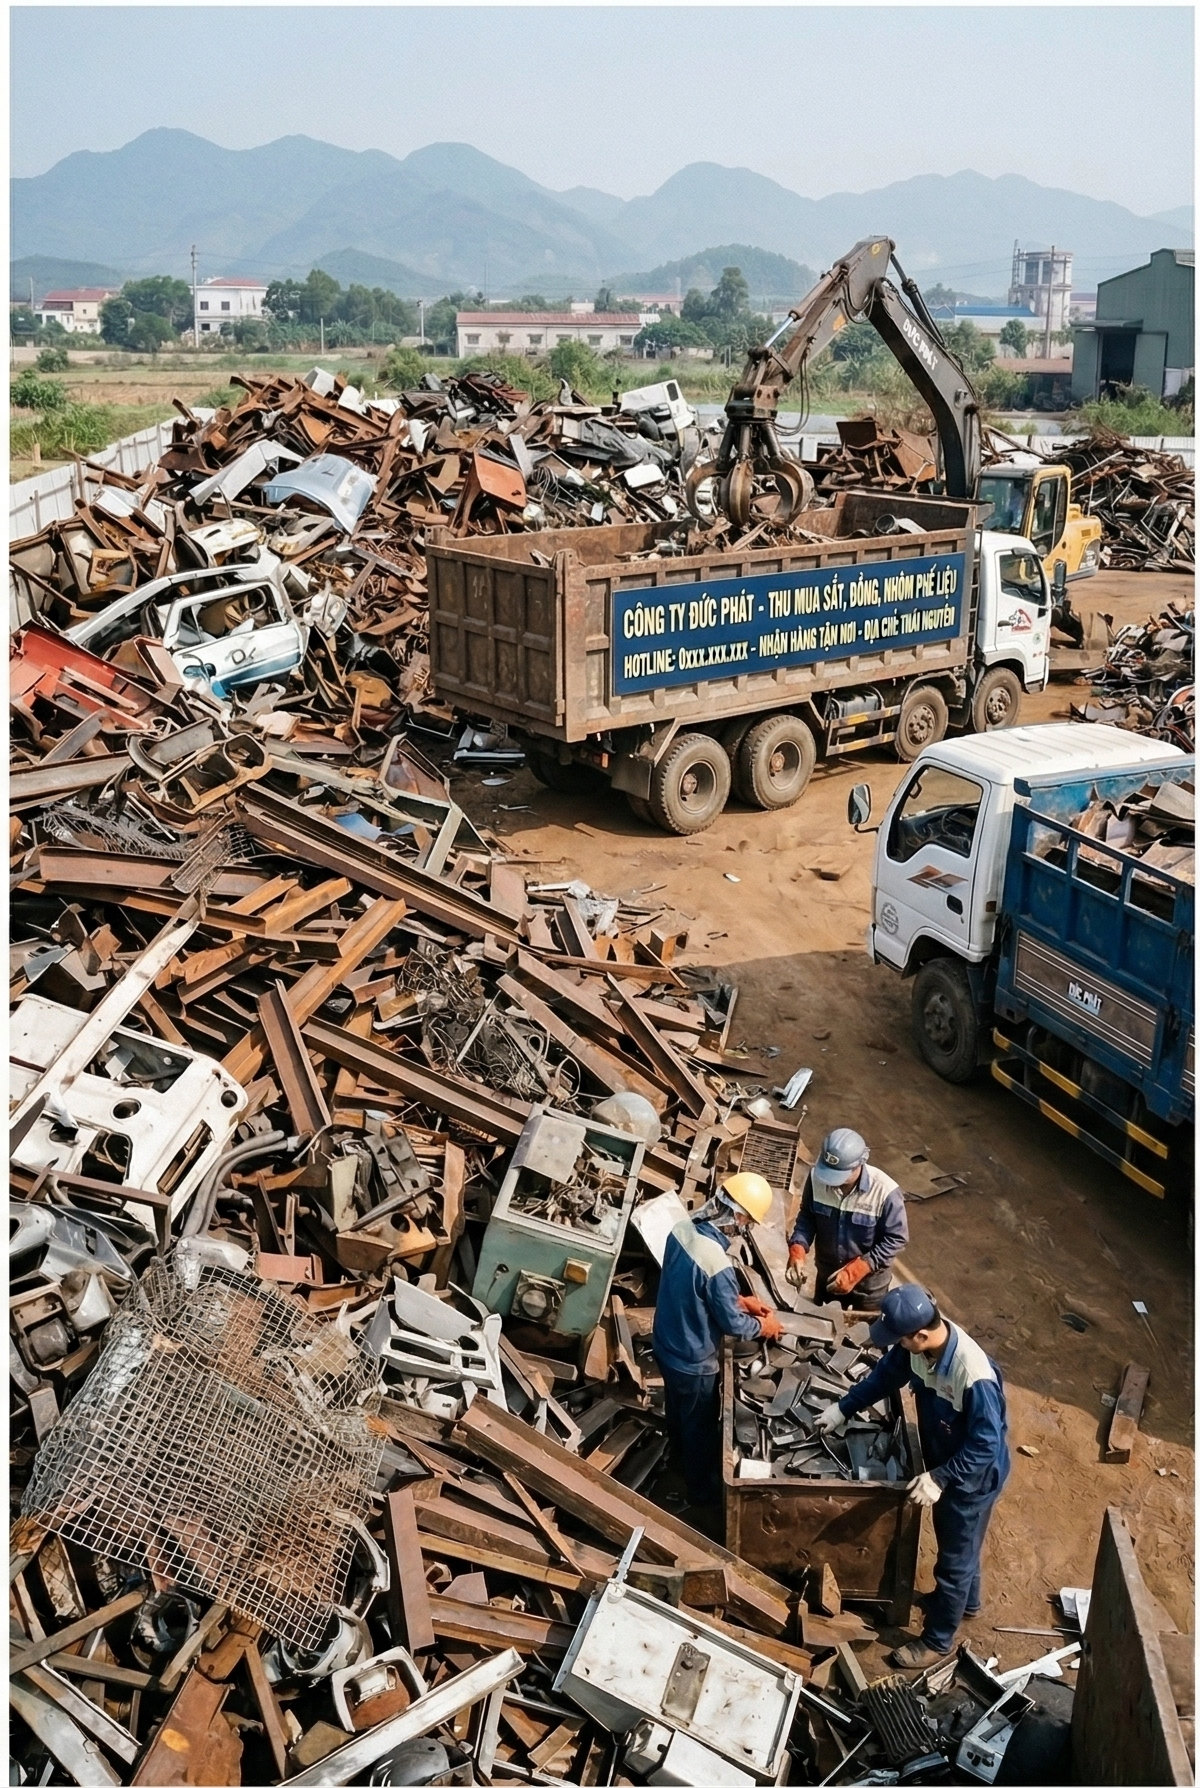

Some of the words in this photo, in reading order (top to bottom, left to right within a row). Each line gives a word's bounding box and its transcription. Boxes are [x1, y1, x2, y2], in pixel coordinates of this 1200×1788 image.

[623, 601, 665, 639] CÔNG
[669, 602, 686, 633] TY
[688, 592, 717, 630] ĐỨC
[720, 588, 755, 626] PHÁT
[768, 589, 791, 619] THU
[794, 586, 820, 615] MUA
[884, 570, 914, 603] NHÔM
[759, 628, 788, 659] NHẬN
[790, 625, 817, 652] HÀNG
